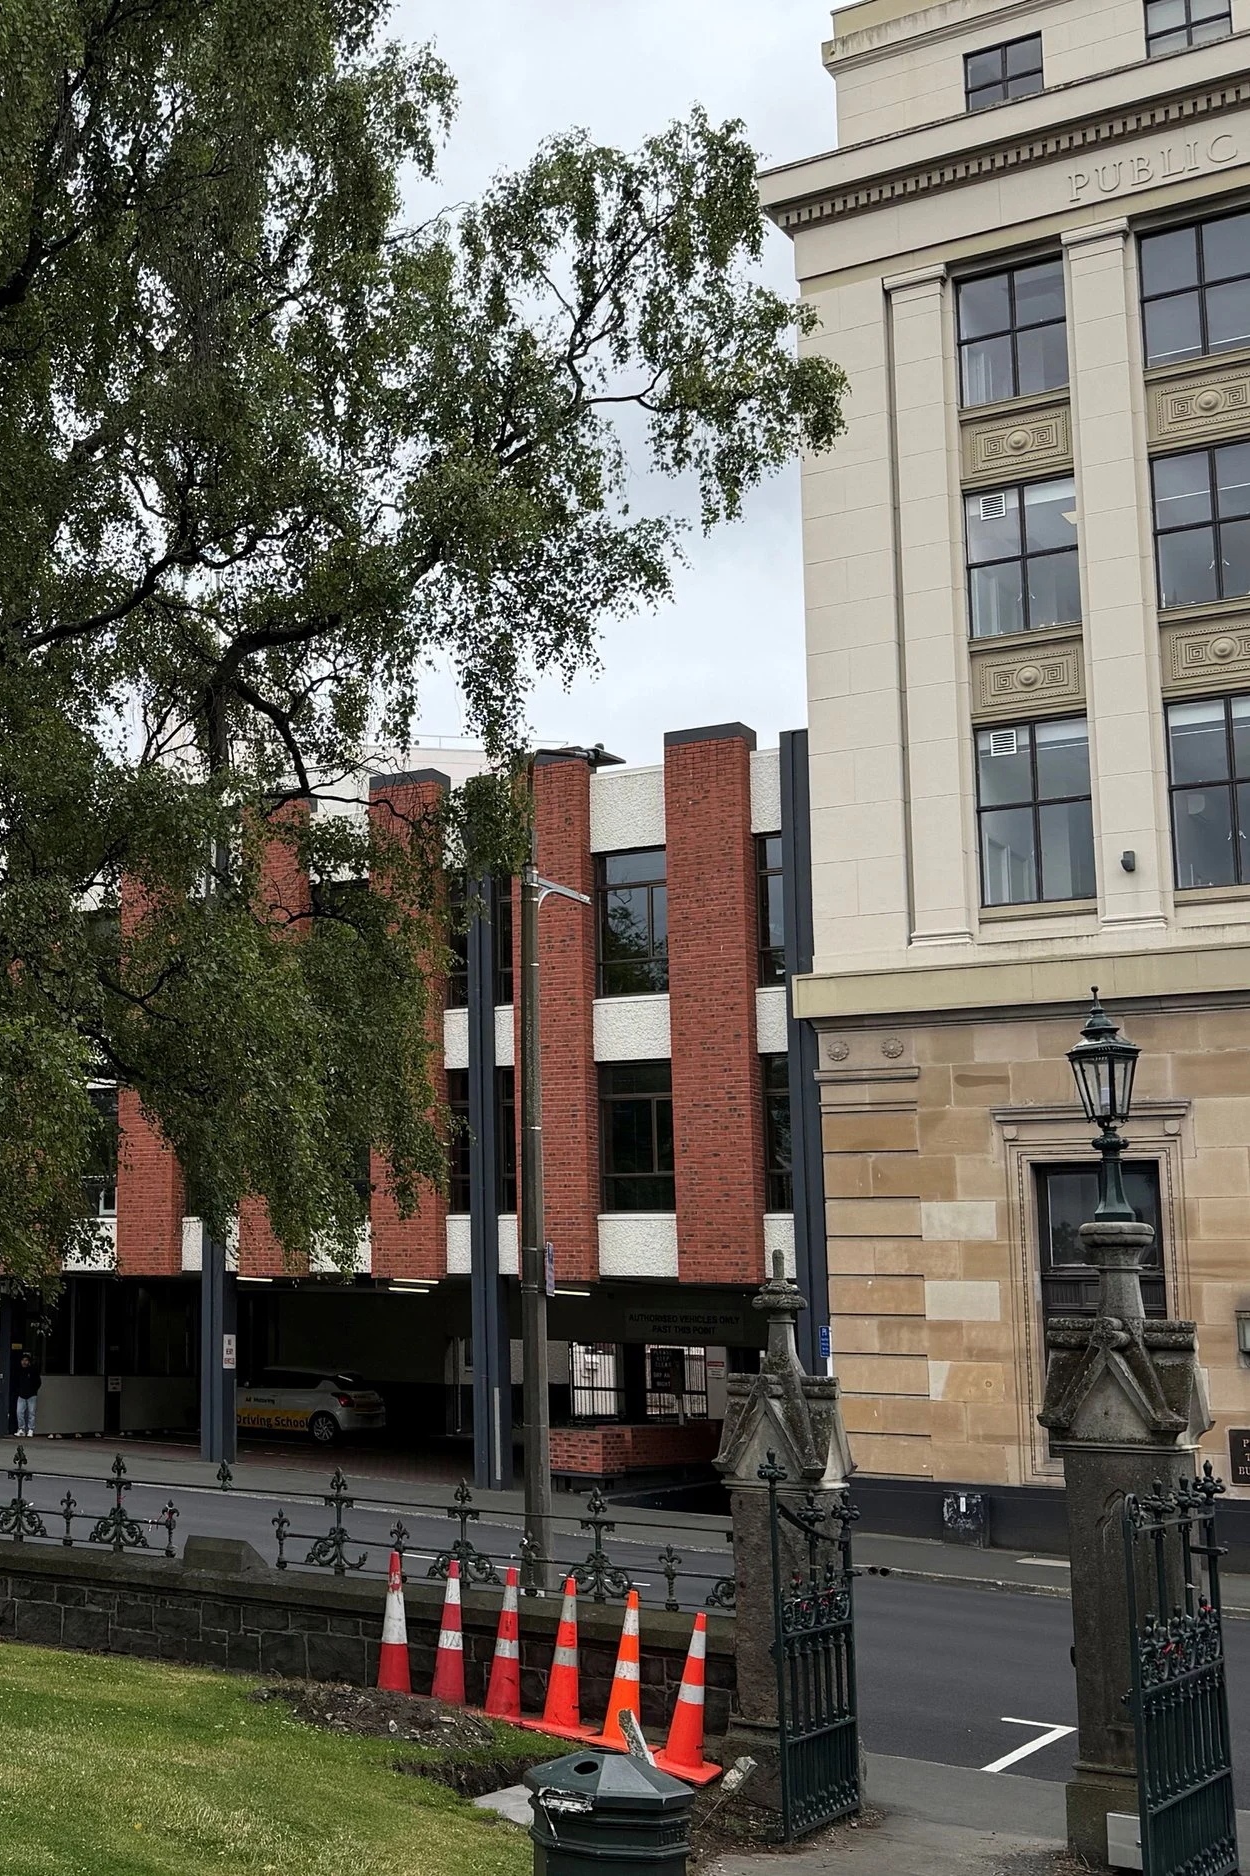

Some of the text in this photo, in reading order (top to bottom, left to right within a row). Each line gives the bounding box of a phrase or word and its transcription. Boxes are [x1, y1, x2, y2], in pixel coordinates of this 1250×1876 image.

[1067, 134, 1239, 203] PUBLIC
[629, 1313, 740, 1325] AUTHORISED VEHICLES ONLY
[652, 1325, 716, 1335] PAST THIS POINT
[236, 1414, 310, 1428] Driving School
